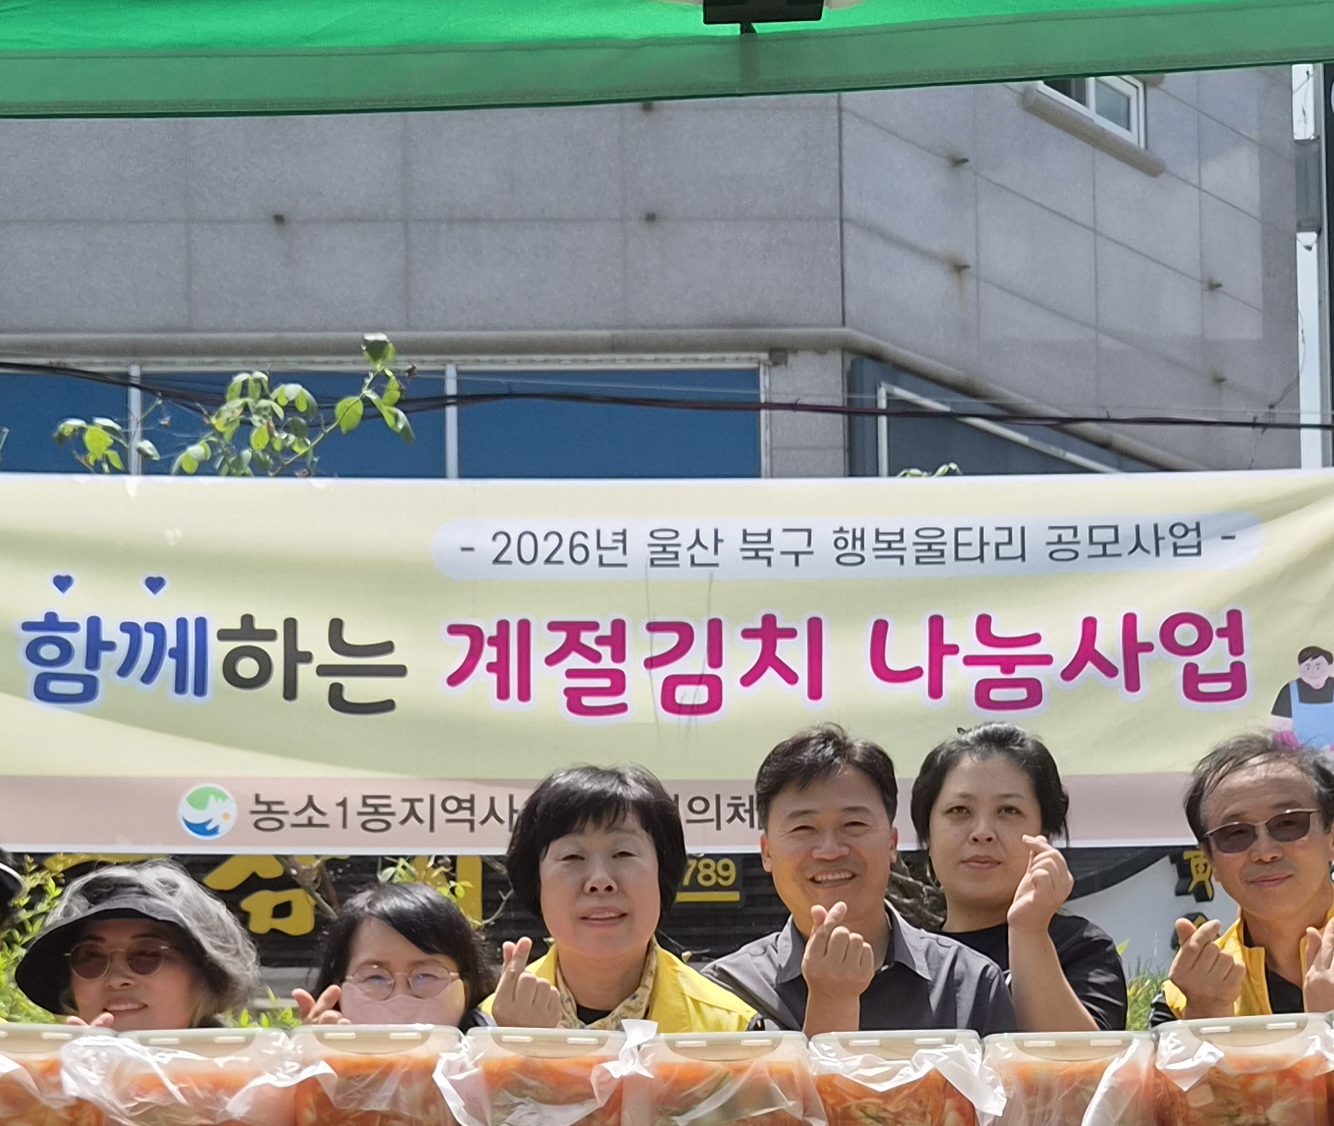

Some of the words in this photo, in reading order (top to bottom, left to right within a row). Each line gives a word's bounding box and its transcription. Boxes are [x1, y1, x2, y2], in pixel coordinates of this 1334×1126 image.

[491, 528, 629, 569] 2026년
[645, 527, 724, 568] 울산
[739, 525, 815, 568] 북구
[831, 524, 1028, 566] 행복울타리
[1045, 520, 1203, 562] 공모사업
[23, 610, 408, 715] 함께하는
[446, 613, 826, 720] 계절김치
[870, 608, 1251, 711] 나눔사업
